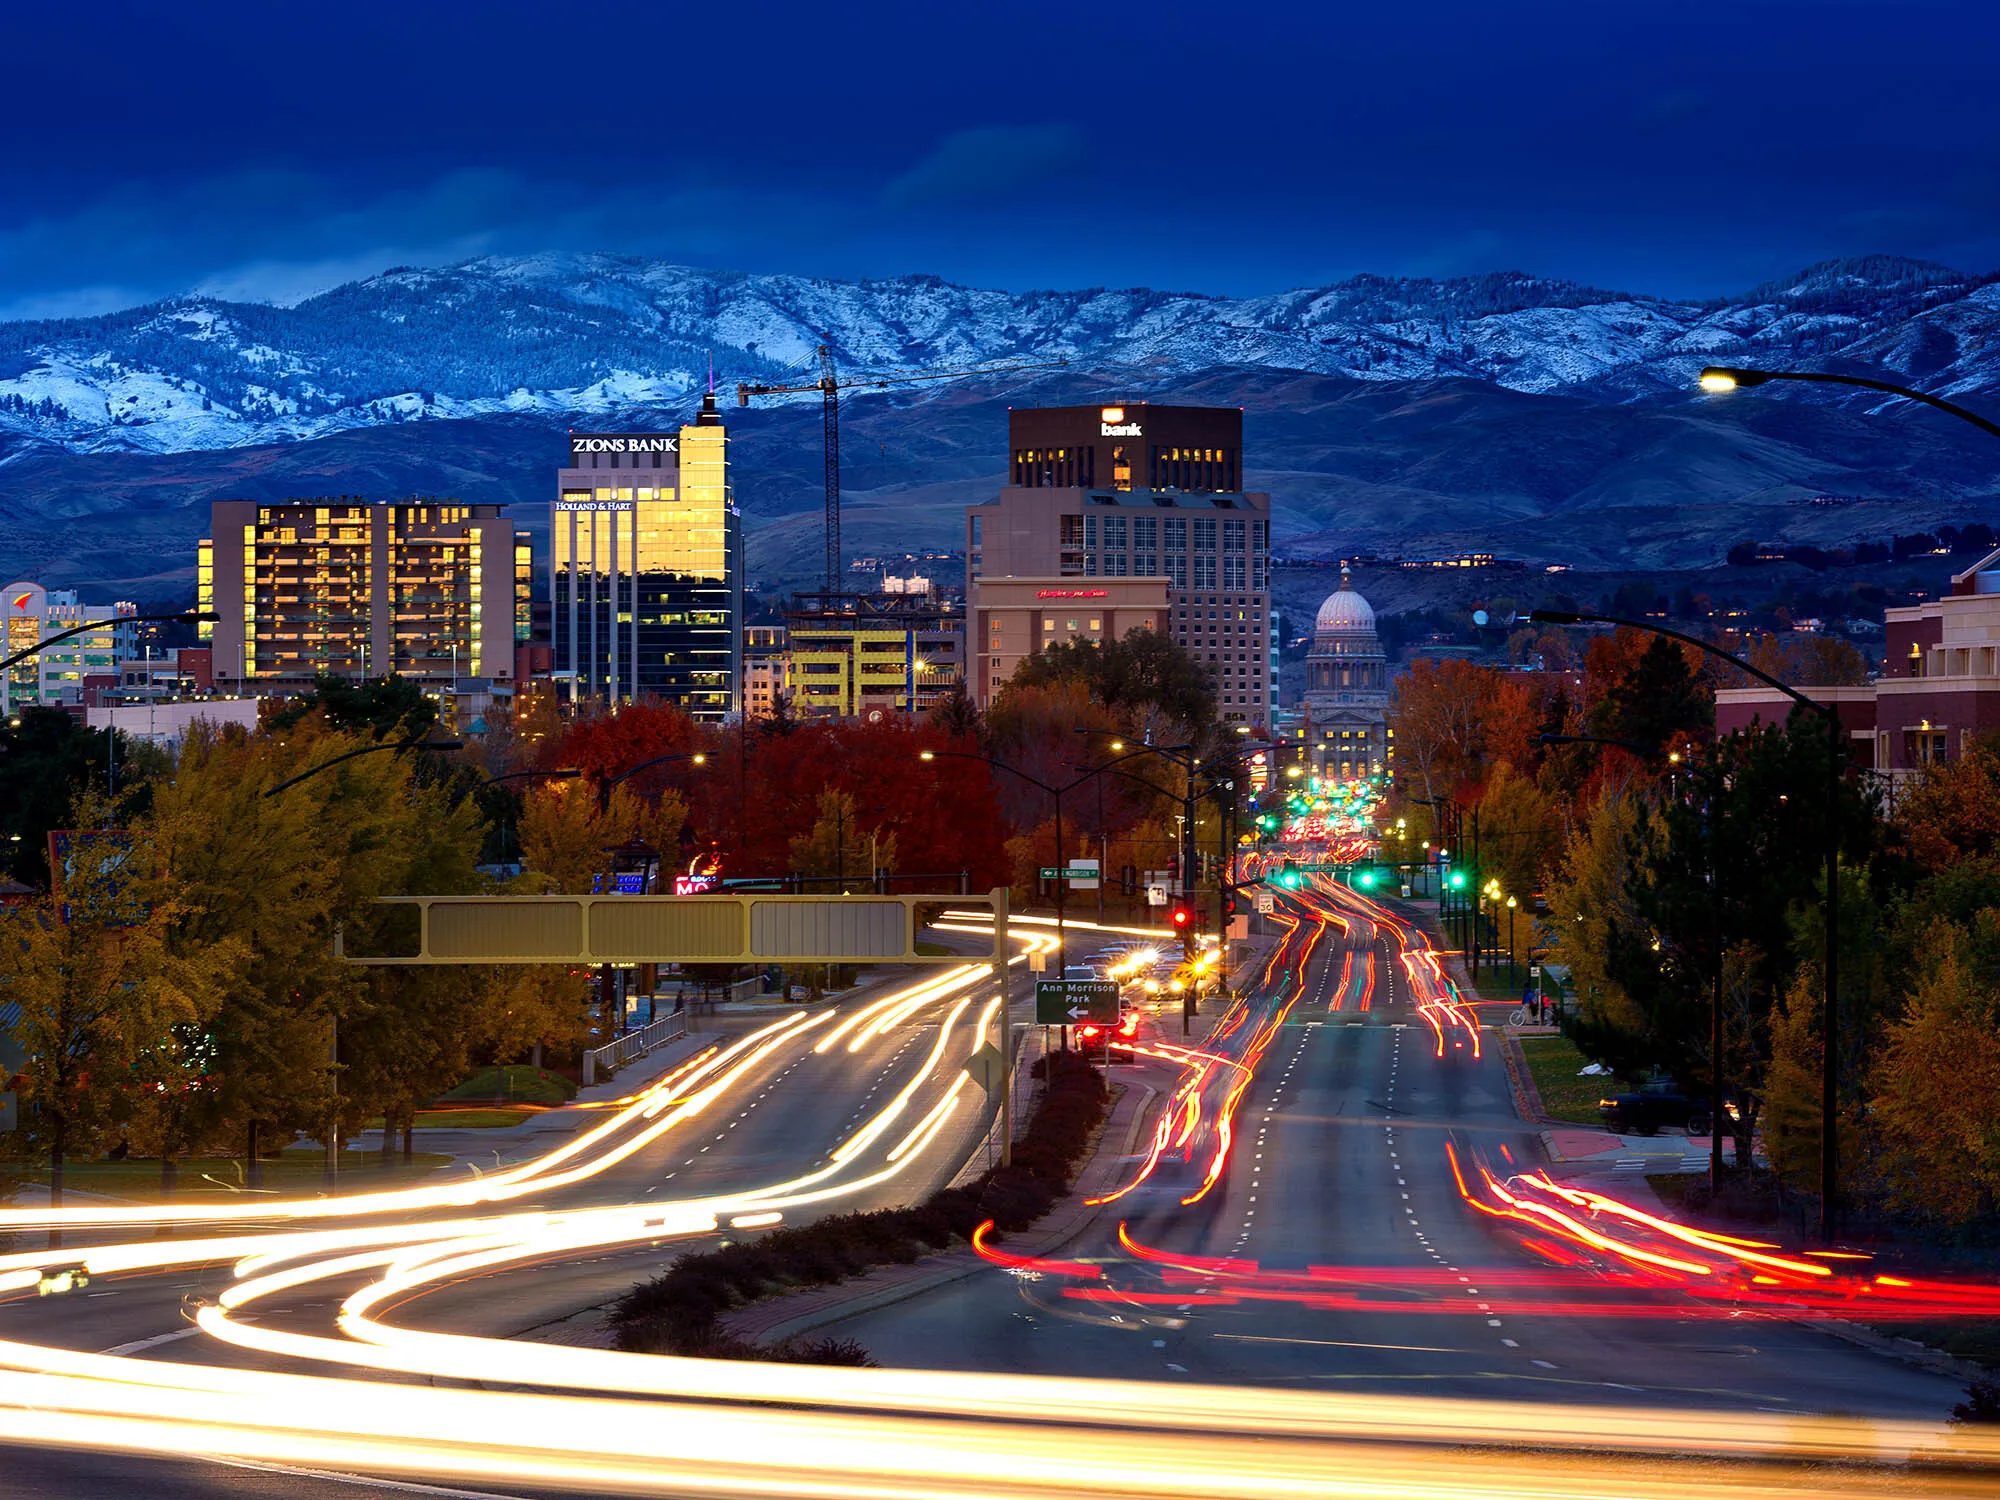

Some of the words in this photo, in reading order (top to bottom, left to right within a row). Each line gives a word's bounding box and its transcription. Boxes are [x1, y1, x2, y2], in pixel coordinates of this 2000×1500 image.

[1101, 423, 1142, 436] bank
[573, 438, 625, 453] ZIONS
[628, 438, 678, 453] BANK
[555, 502, 597, 511] HOLLAND
[598, 502, 606, 511] &
[609, 502, 632, 511] HART
[1260, 904, 1272, 912] 30
[1041, 983, 1063, 992] Ann
[1067, 983, 1115, 992] Morrison
[1065, 994, 1090, 1003] Park
